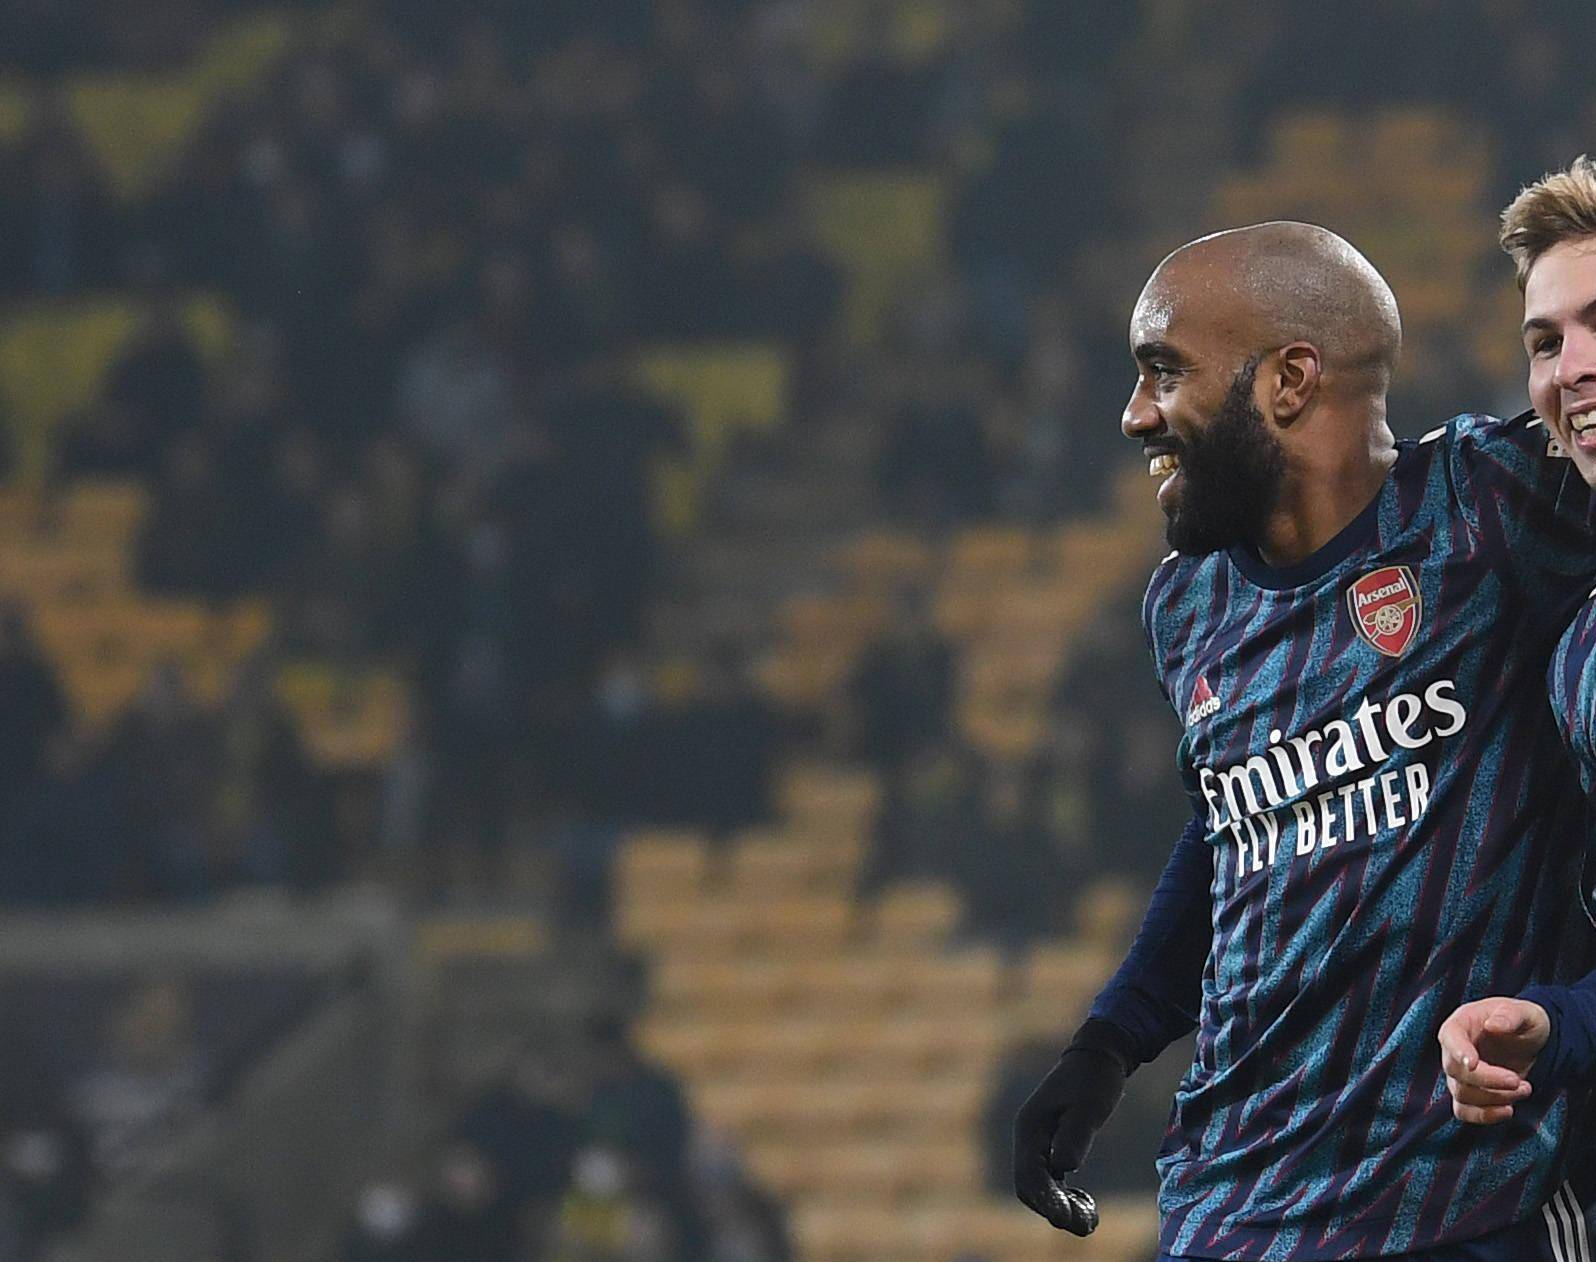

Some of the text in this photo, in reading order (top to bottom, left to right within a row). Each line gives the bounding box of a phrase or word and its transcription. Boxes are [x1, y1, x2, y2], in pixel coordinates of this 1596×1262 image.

[1358, 577, 1407, 608] Arsenal
[1188, 696, 1221, 727] adidas
[1199, 680, 1467, 833] Emirates
[1230, 762, 1430, 878] FLY BETTER
